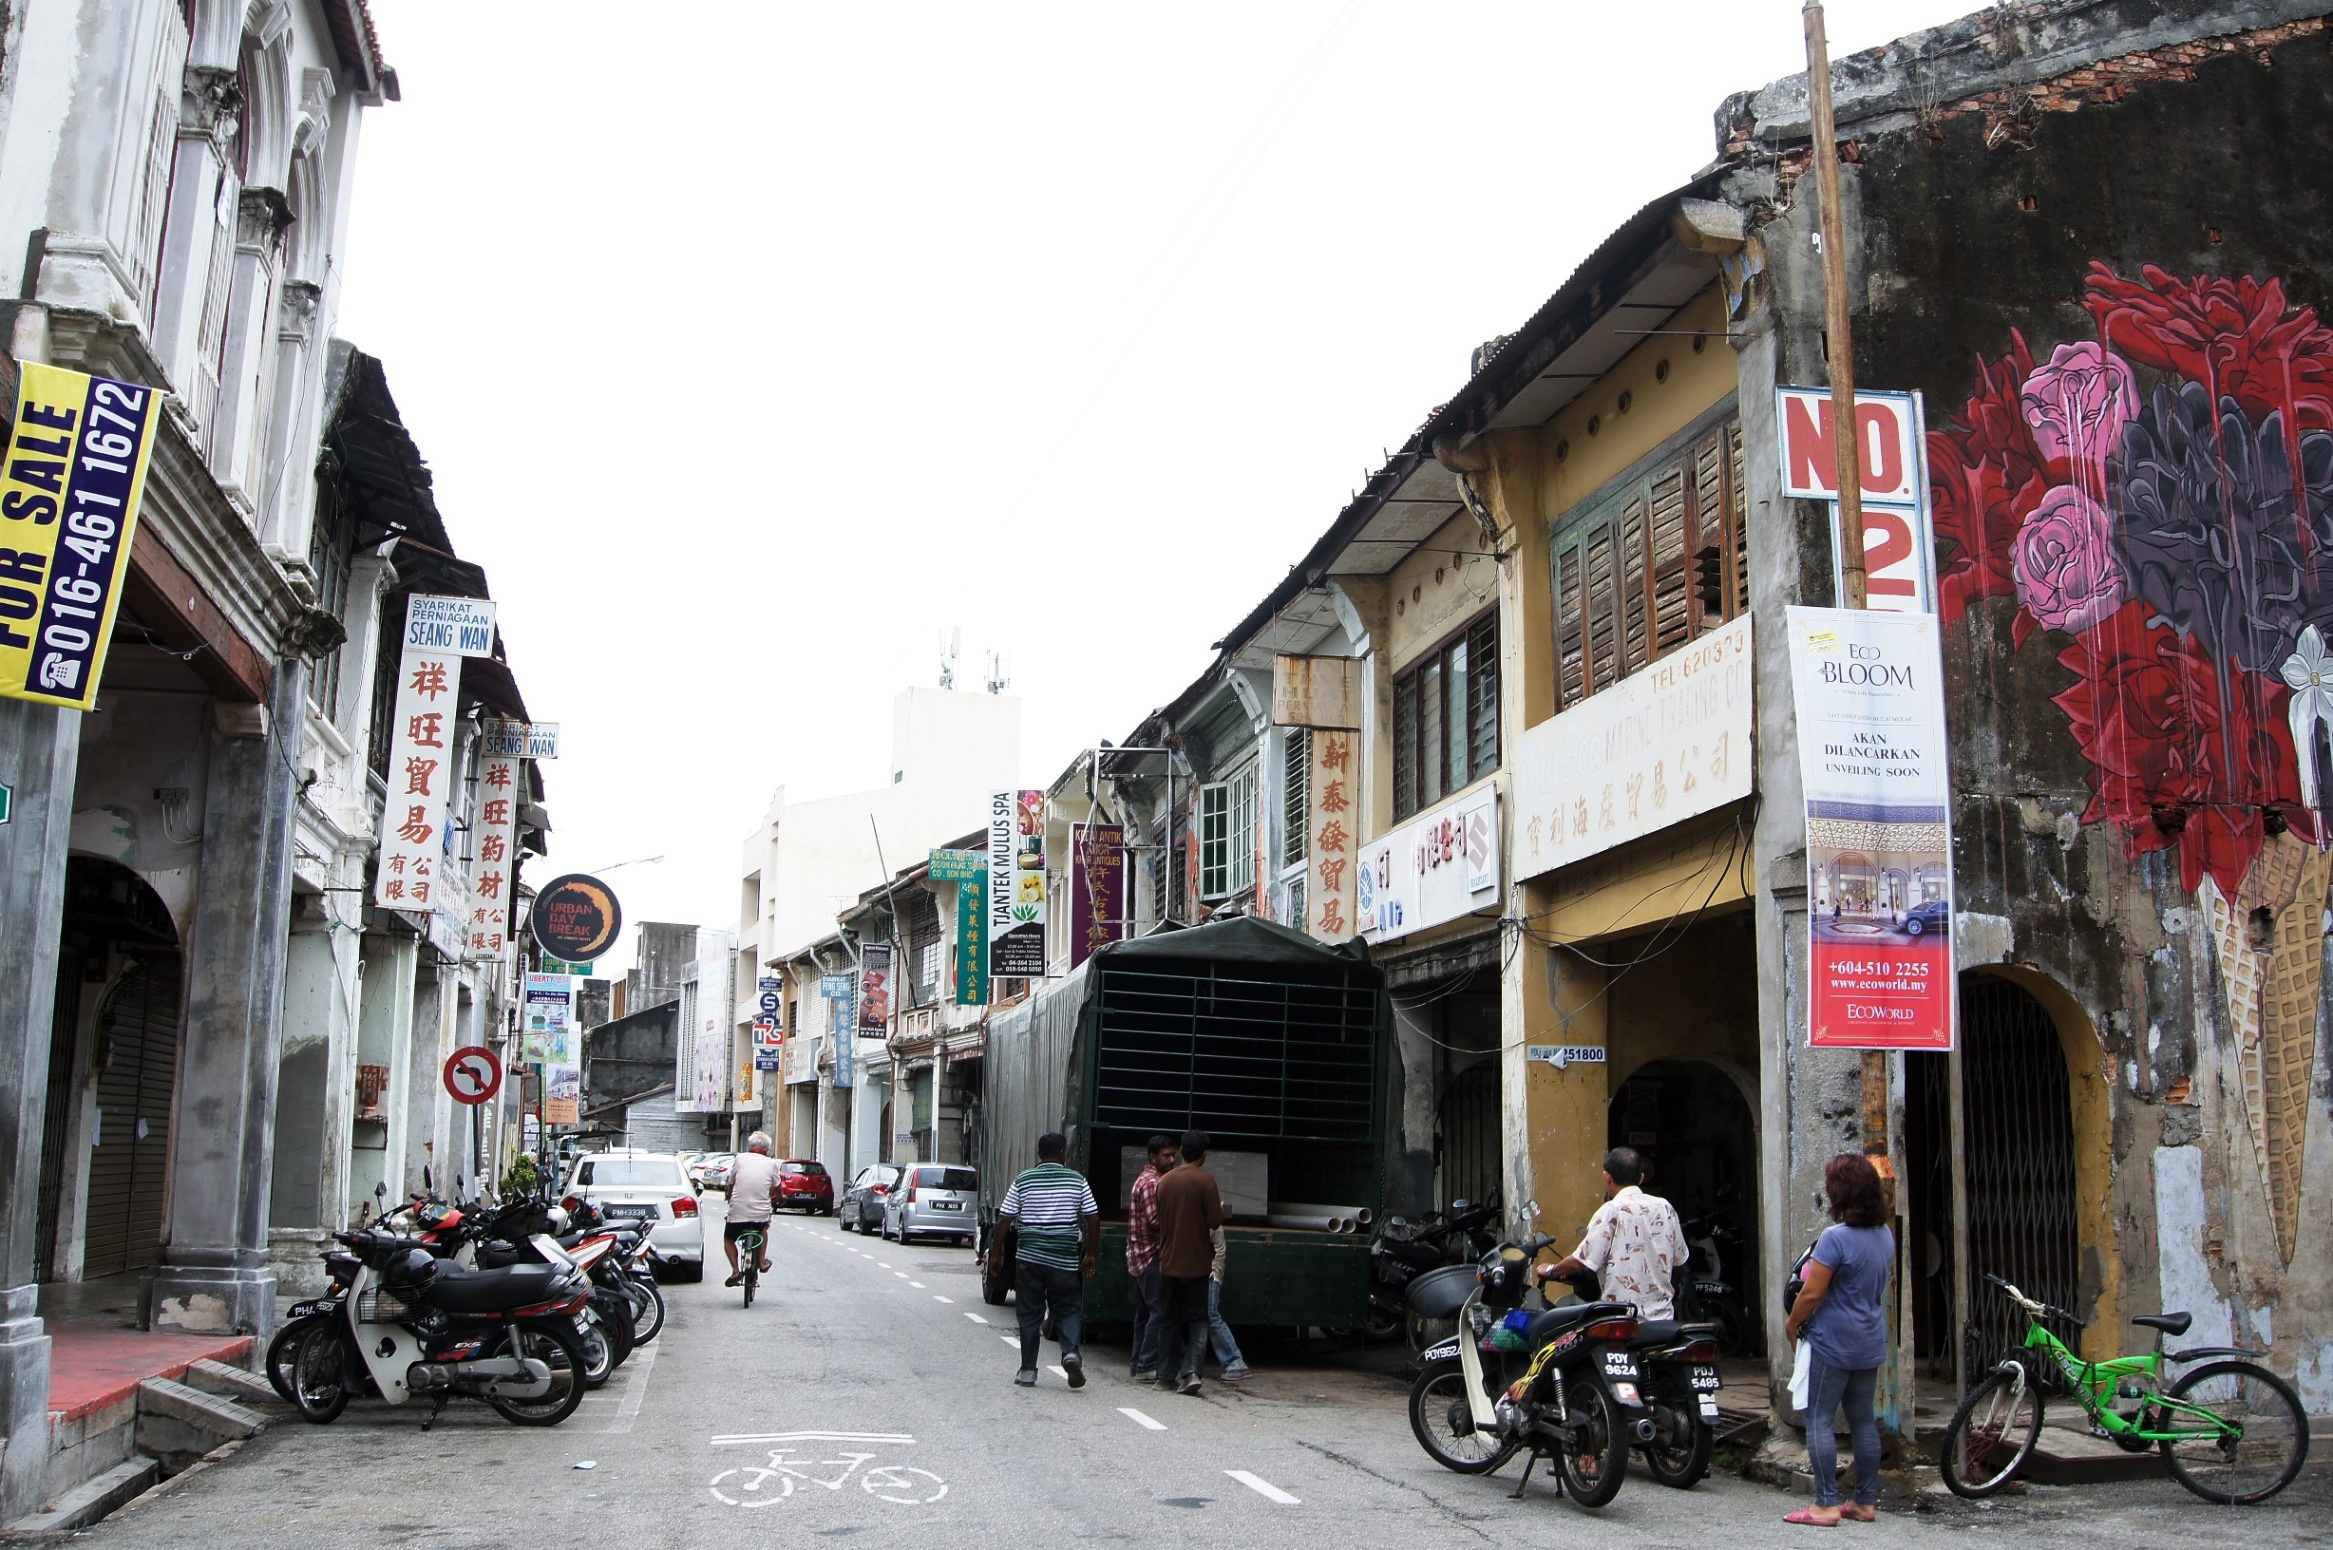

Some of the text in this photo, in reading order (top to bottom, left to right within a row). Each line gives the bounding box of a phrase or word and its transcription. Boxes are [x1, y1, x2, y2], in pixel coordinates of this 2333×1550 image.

[1785, 396, 1911, 495] NO.
[2, 400, 77, 526] SALE
[44, 381, 144, 652] 016-461 1672
[1862, 510, 1916, 598] 2
[413, 599, 472, 613] SYARIKAT
[412, 609, 489, 625] PERNIAGAAN
[408, 621, 489, 651] SEANG WAN
[1823, 660, 1916, 691] BLOOM
[487, 729, 556, 739] PERNIAGAAN
[1851, 732, 1887, 745] AKAN
[486, 736, 555, 756] SEANG WAN
[1824, 743, 1921, 760] DILANCARKAN
[1825, 763, 1921, 777] UNVEILING SOON
[992, 791, 1010, 820] SPA
[992, 820, 1011, 868] MULUS
[1099, 831, 1122, 844] ANTIK
[992, 870, 1011, 928] TJANTEK
[550, 902, 593, 915] URBAN
[549, 912, 576, 925] DAY
[548, 923, 590, 936] BREAK
[1828, 960, 1929, 977] +604-510 2255
[1830, 978, 1928, 993] www.ecoworld.my
[1606, 1352, 1629, 1365] PDY
[1604, 1364, 1638, 1376] 9624
[1693, 1366, 1715, 1377] PDJ
[1691, 1377, 1720, 1389] 5485
